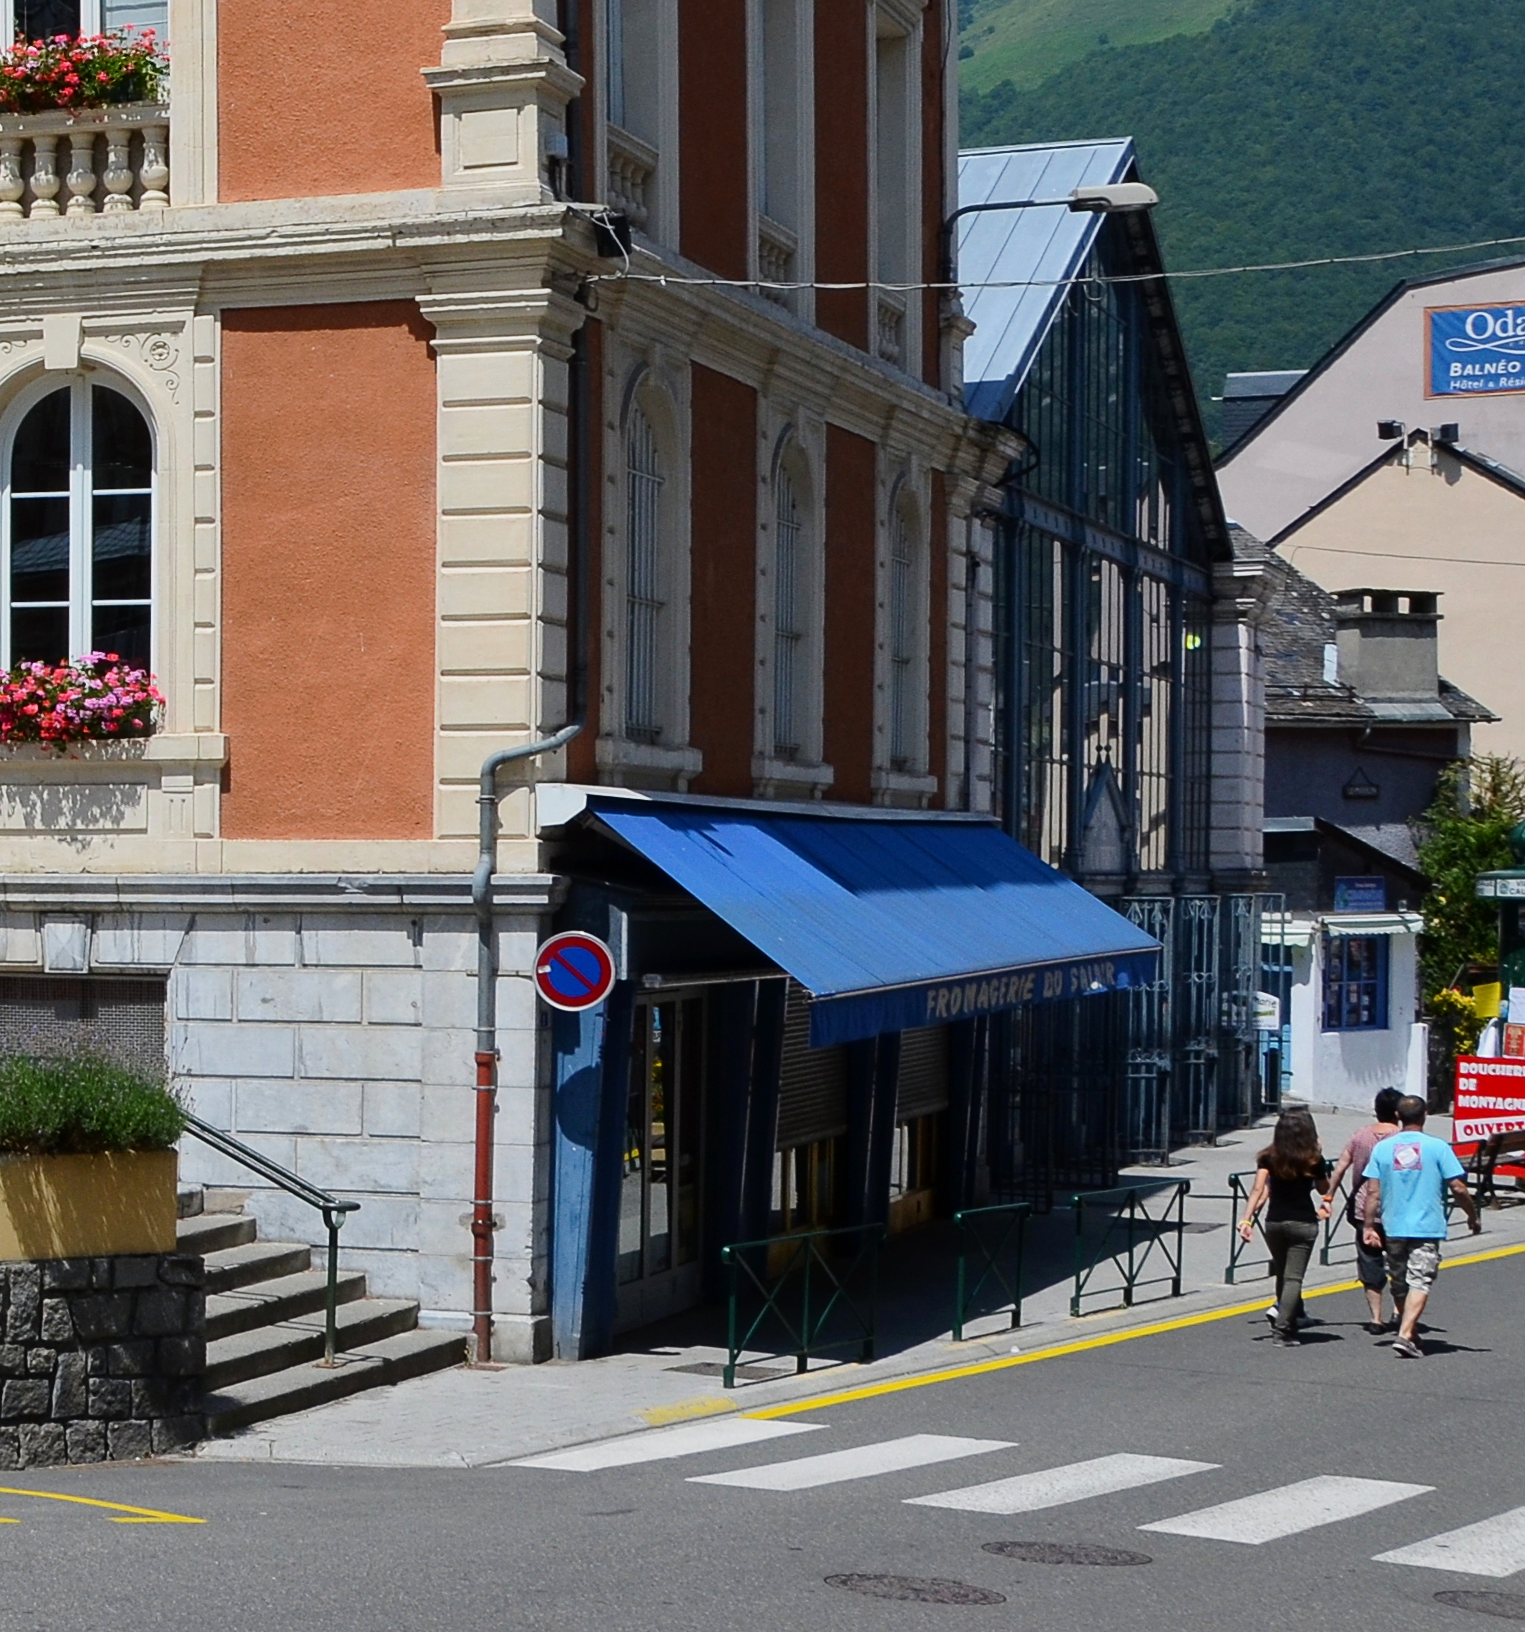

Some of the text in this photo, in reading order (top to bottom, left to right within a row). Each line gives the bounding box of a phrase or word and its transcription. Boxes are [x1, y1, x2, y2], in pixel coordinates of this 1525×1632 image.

[1450, 359, 1521, 377] BALNÉO
[1450, 379, 1484, 390] Hôtel
[926, 972, 1036, 1019] FROMAGERIE
[1043, 970, 1063, 998] DU
[1459, 1077, 1478, 1091] DE
[1463, 1121, 1525, 1136] OUVERT
